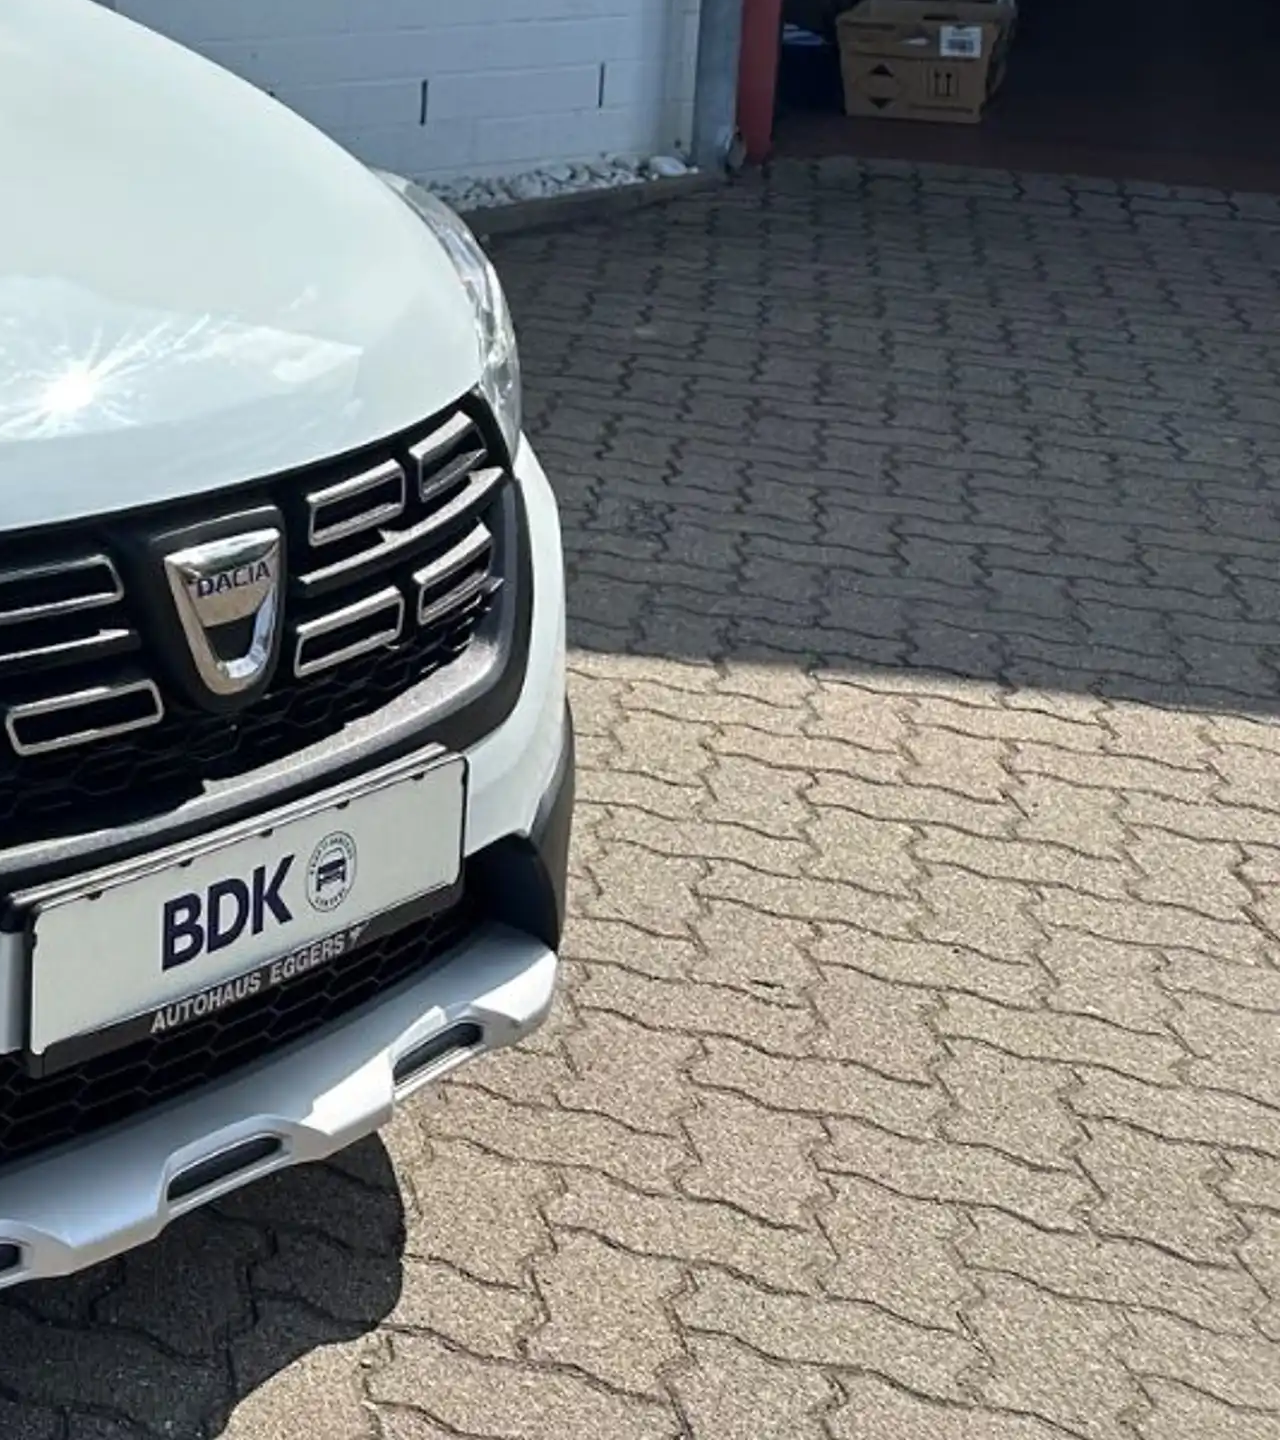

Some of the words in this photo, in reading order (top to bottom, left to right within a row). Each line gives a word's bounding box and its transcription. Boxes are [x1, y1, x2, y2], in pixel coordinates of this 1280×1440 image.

[196, 561, 272, 598] DACIA
[161, 853, 295, 971] BDK
[150, 972, 261, 1034] AUTOHAUS
[269, 936, 345, 984] EGGERS
